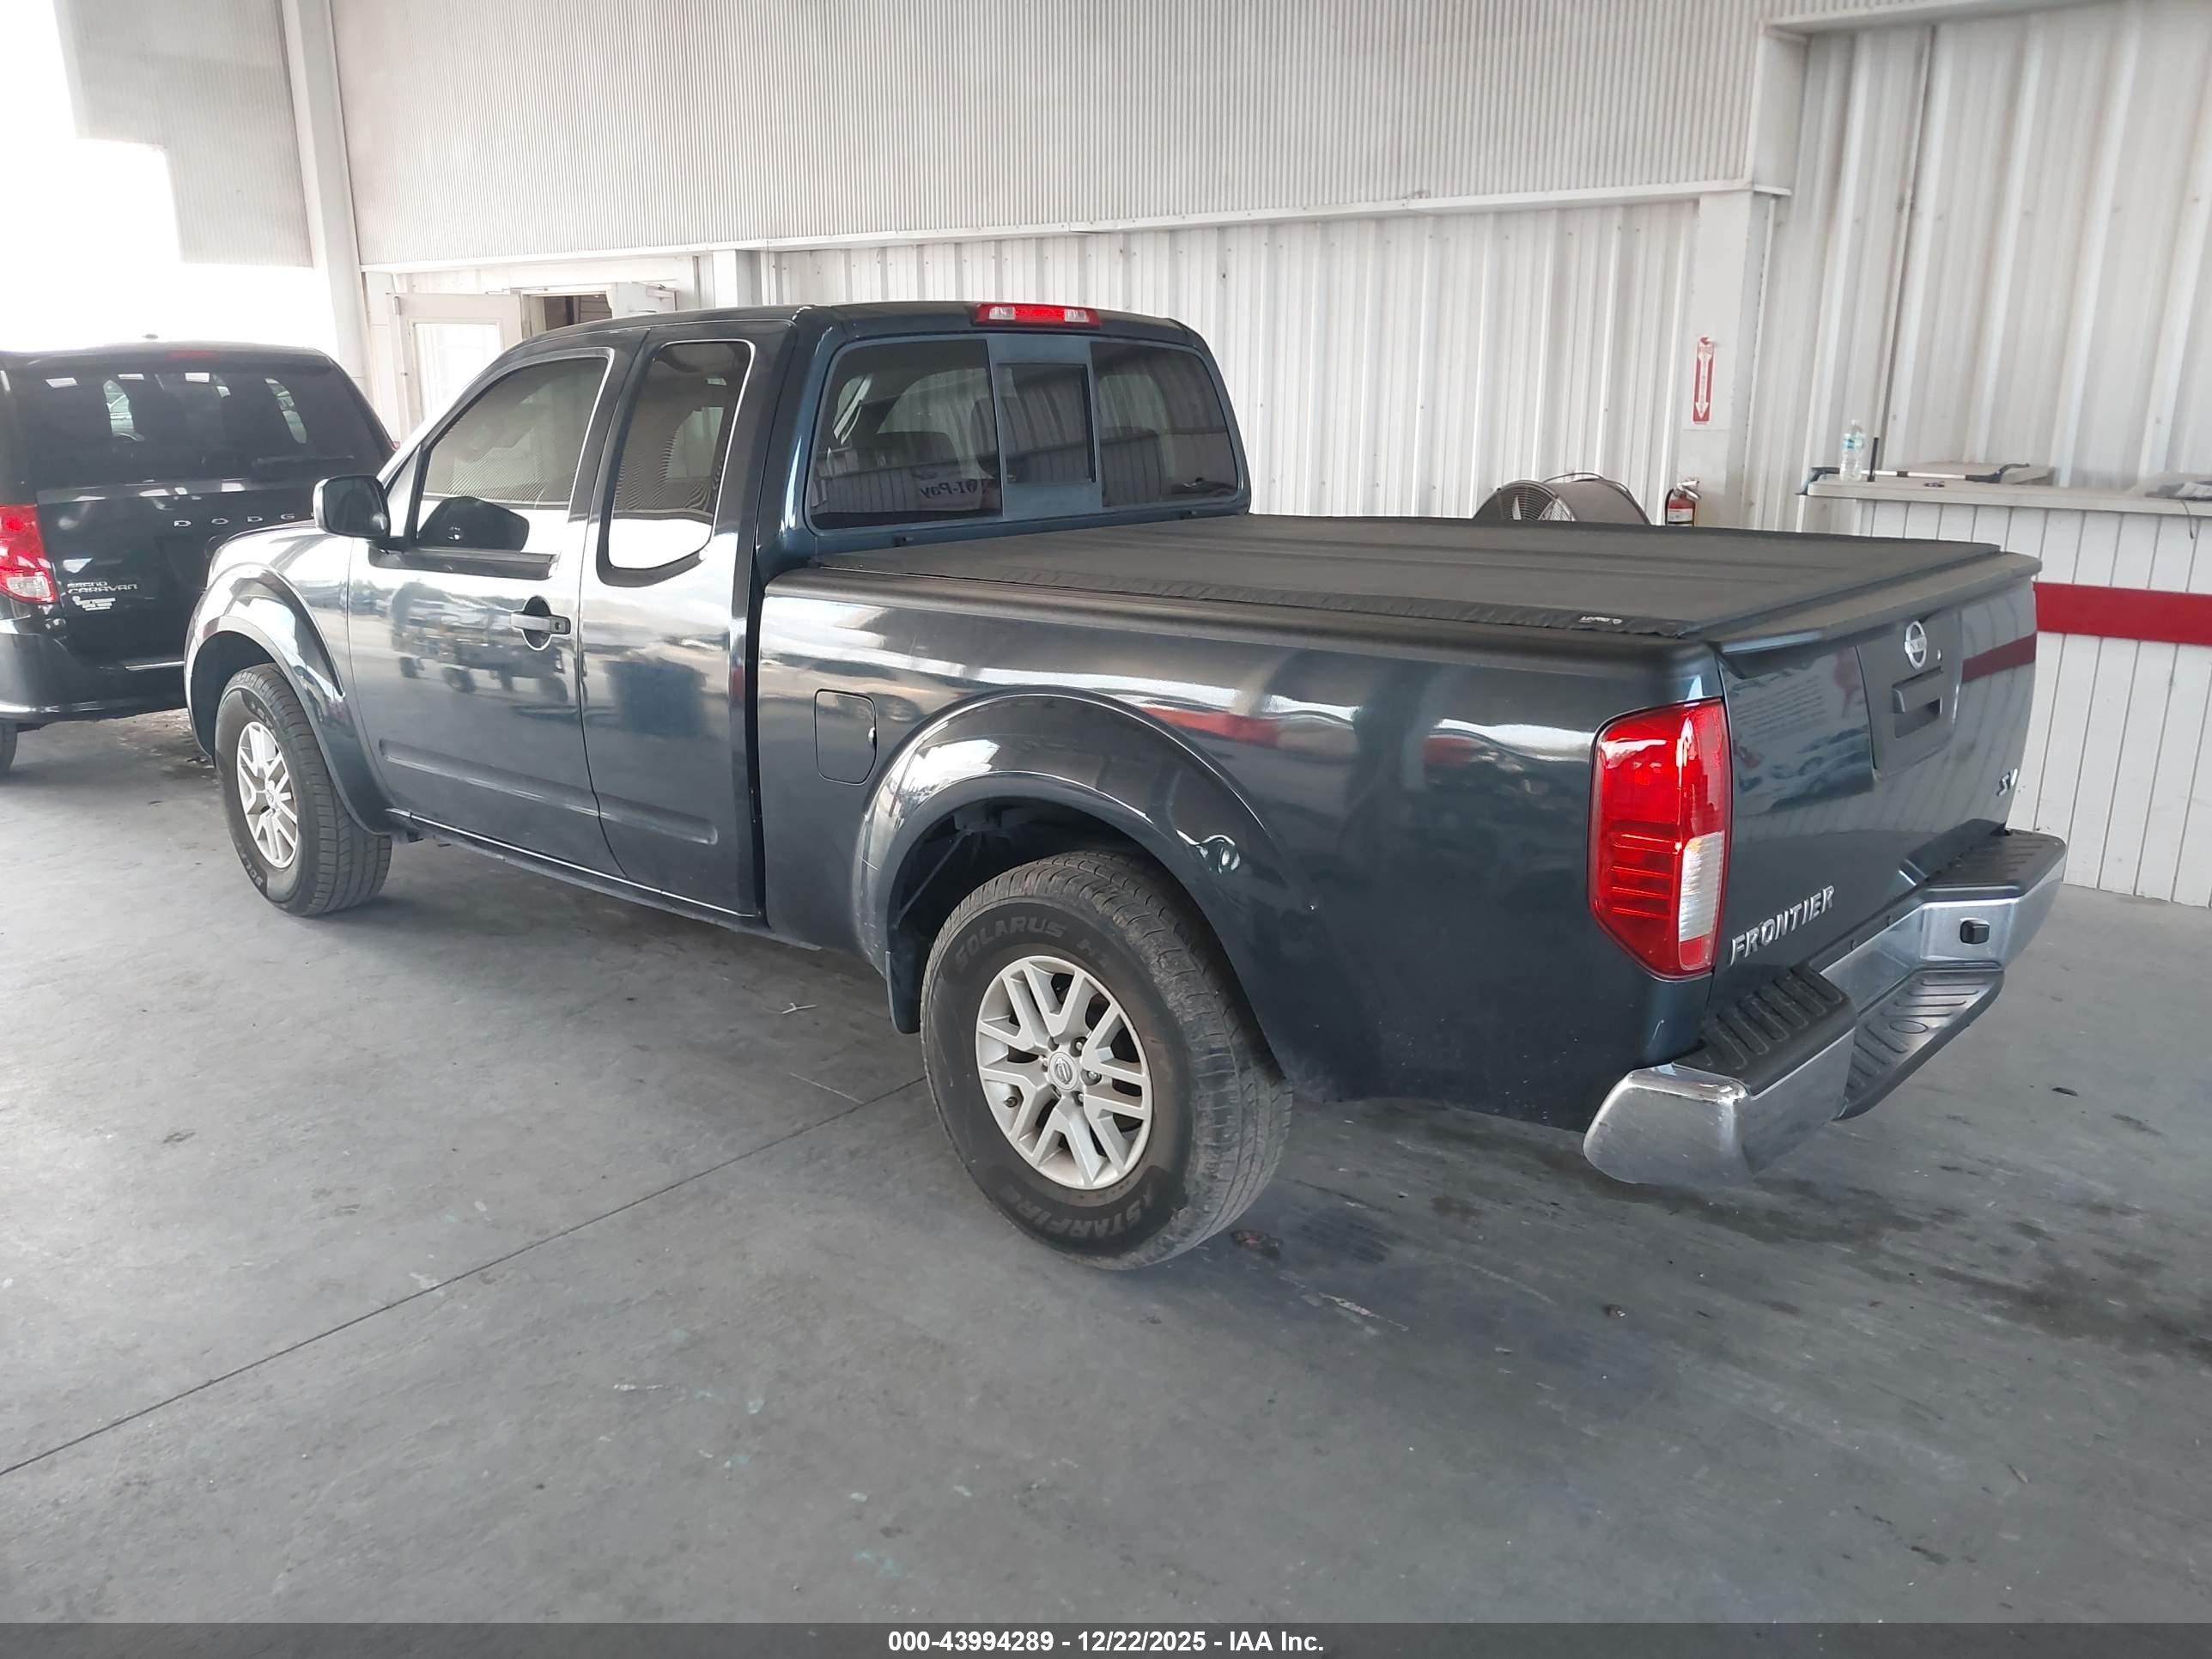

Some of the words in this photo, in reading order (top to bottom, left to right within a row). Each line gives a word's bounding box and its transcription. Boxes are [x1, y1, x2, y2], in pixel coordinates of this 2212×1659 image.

[173, 513, 295, 527] DODG
[68, 583, 138, 594] CARAVAN
[1729, 884, 1835, 966] FRONTIER
[955, 915, 1066, 974] SOLARUS
